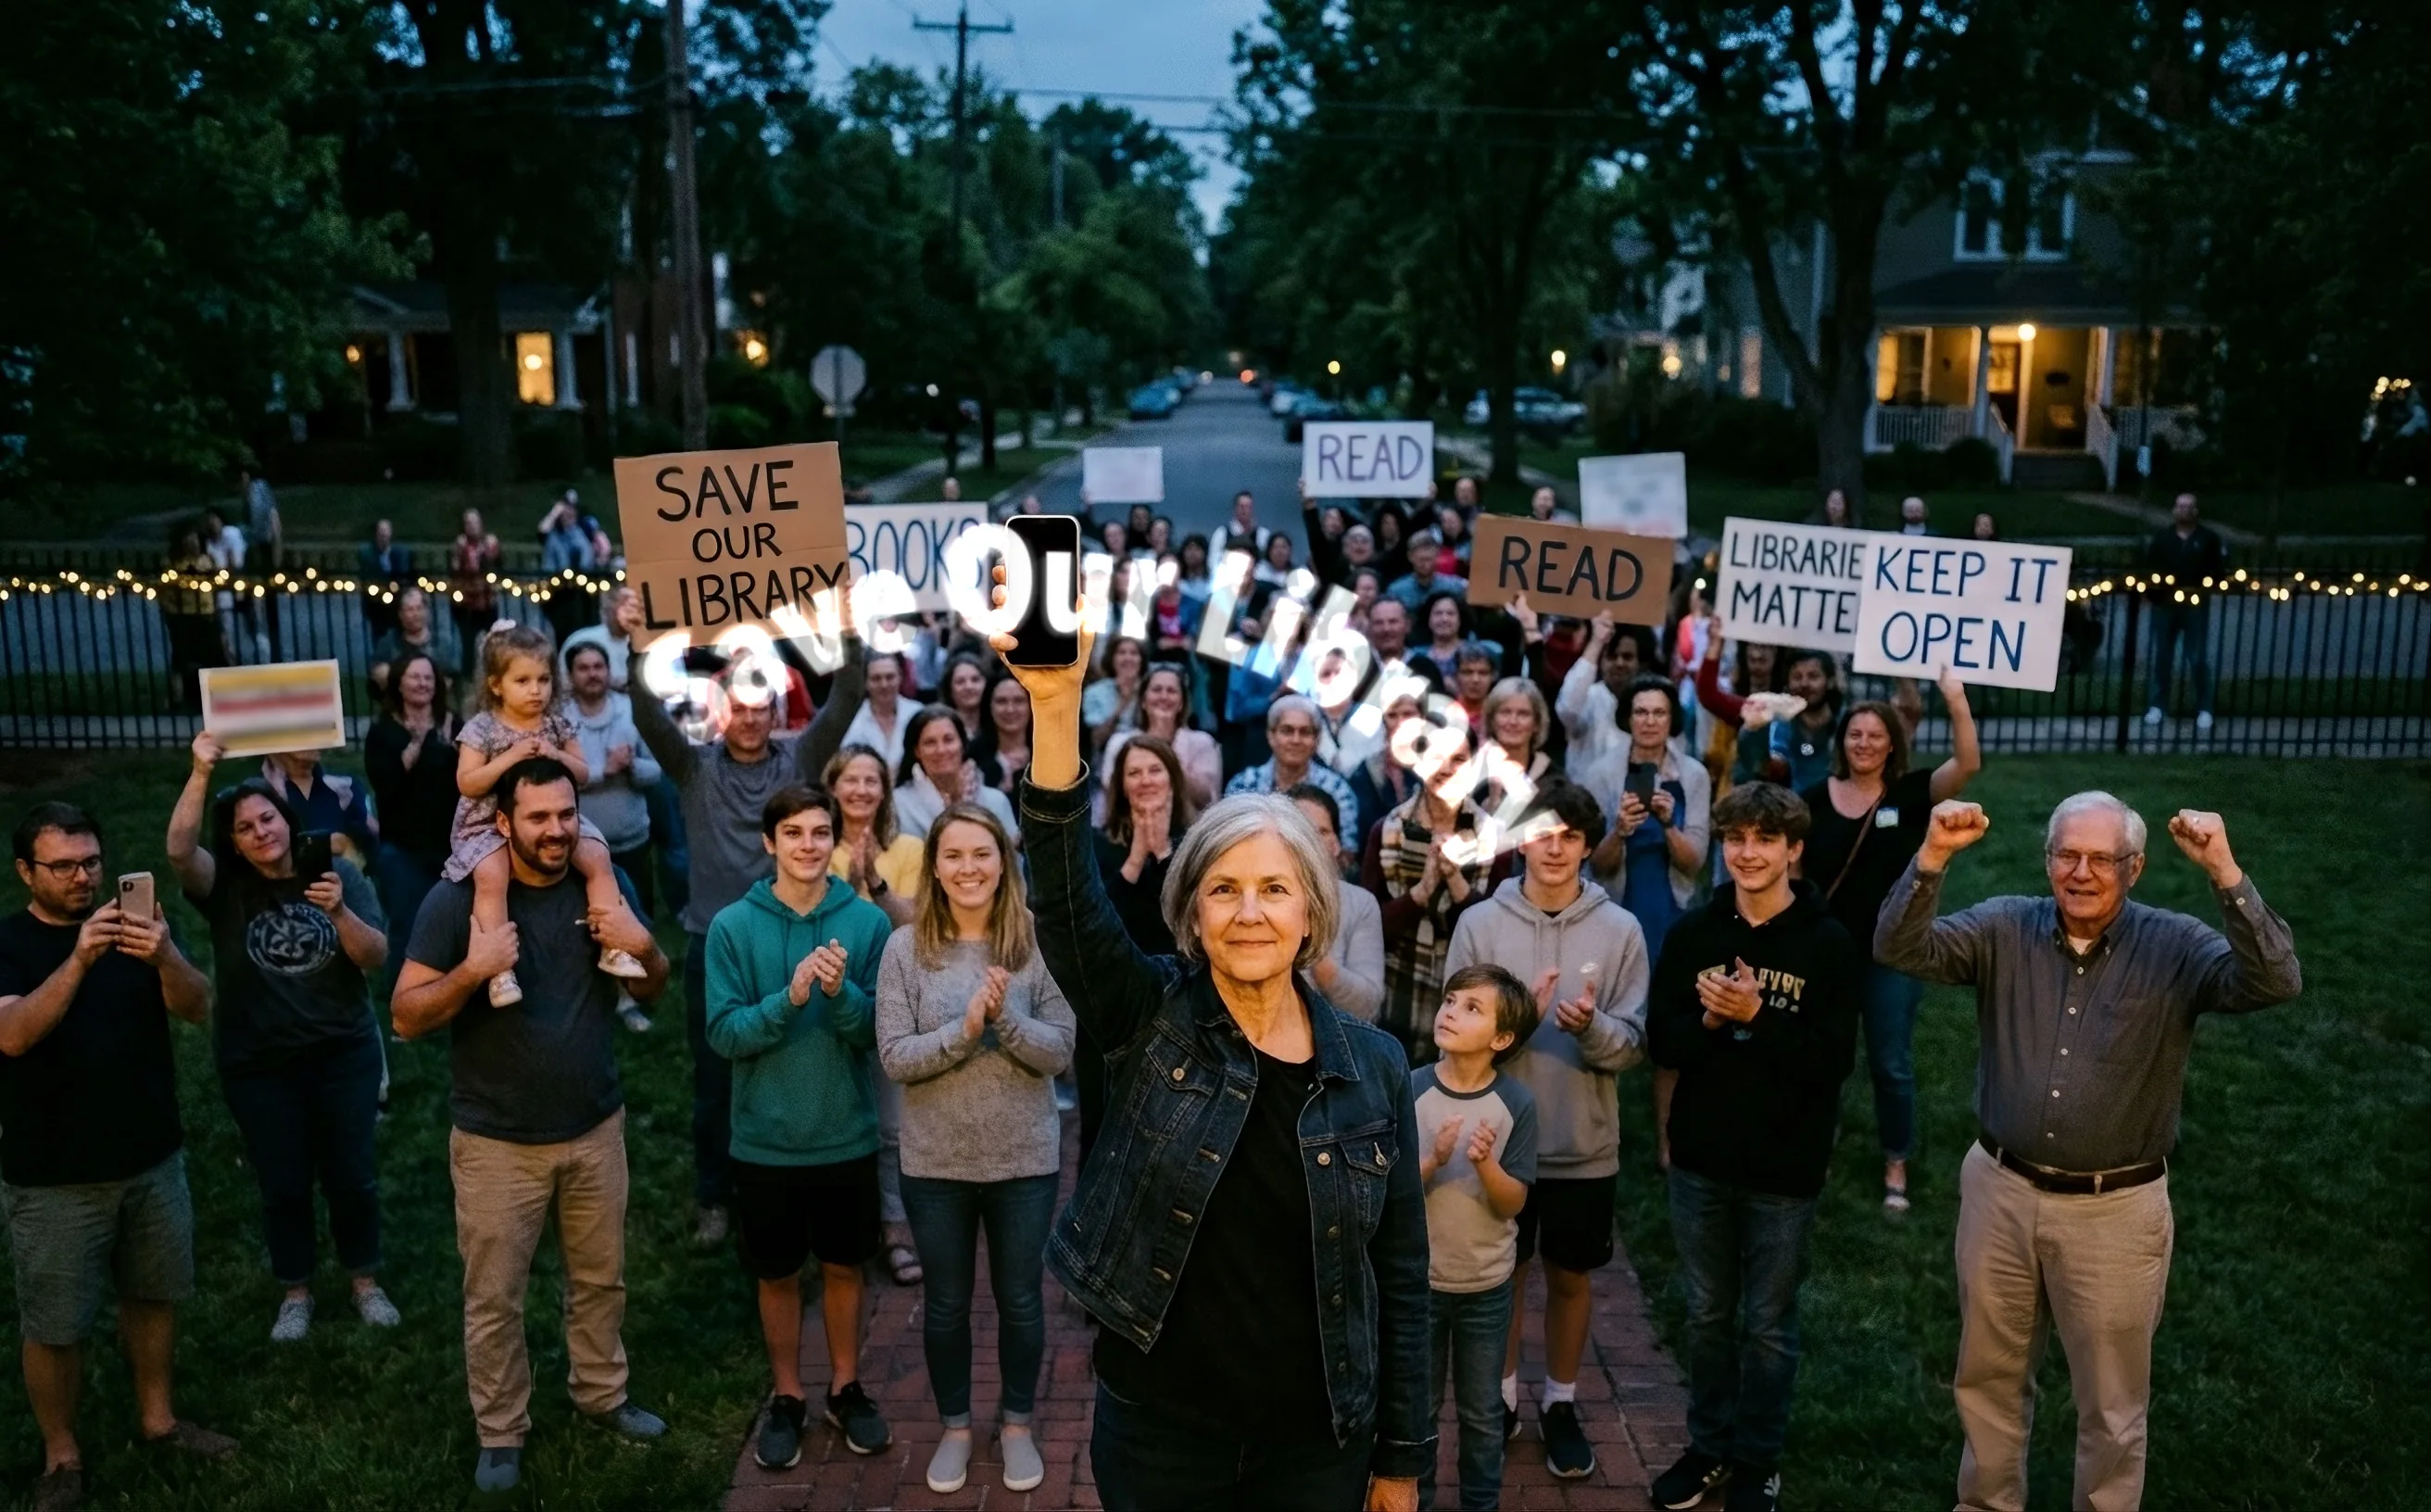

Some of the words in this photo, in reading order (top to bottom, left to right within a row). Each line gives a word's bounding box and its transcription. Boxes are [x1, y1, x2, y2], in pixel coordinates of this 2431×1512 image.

[1317, 435, 1424, 482] READ
[655, 460, 799, 523] SAVE
[692, 522, 783, 563] OUR
[1498, 536, 1644, 602] READ
[1875, 545, 1986, 598] KEEP
[2004, 557, 2059, 604] IT
[1730, 579, 1858, 634] MATTE
[1881, 611, 2027, 673] OPEN
